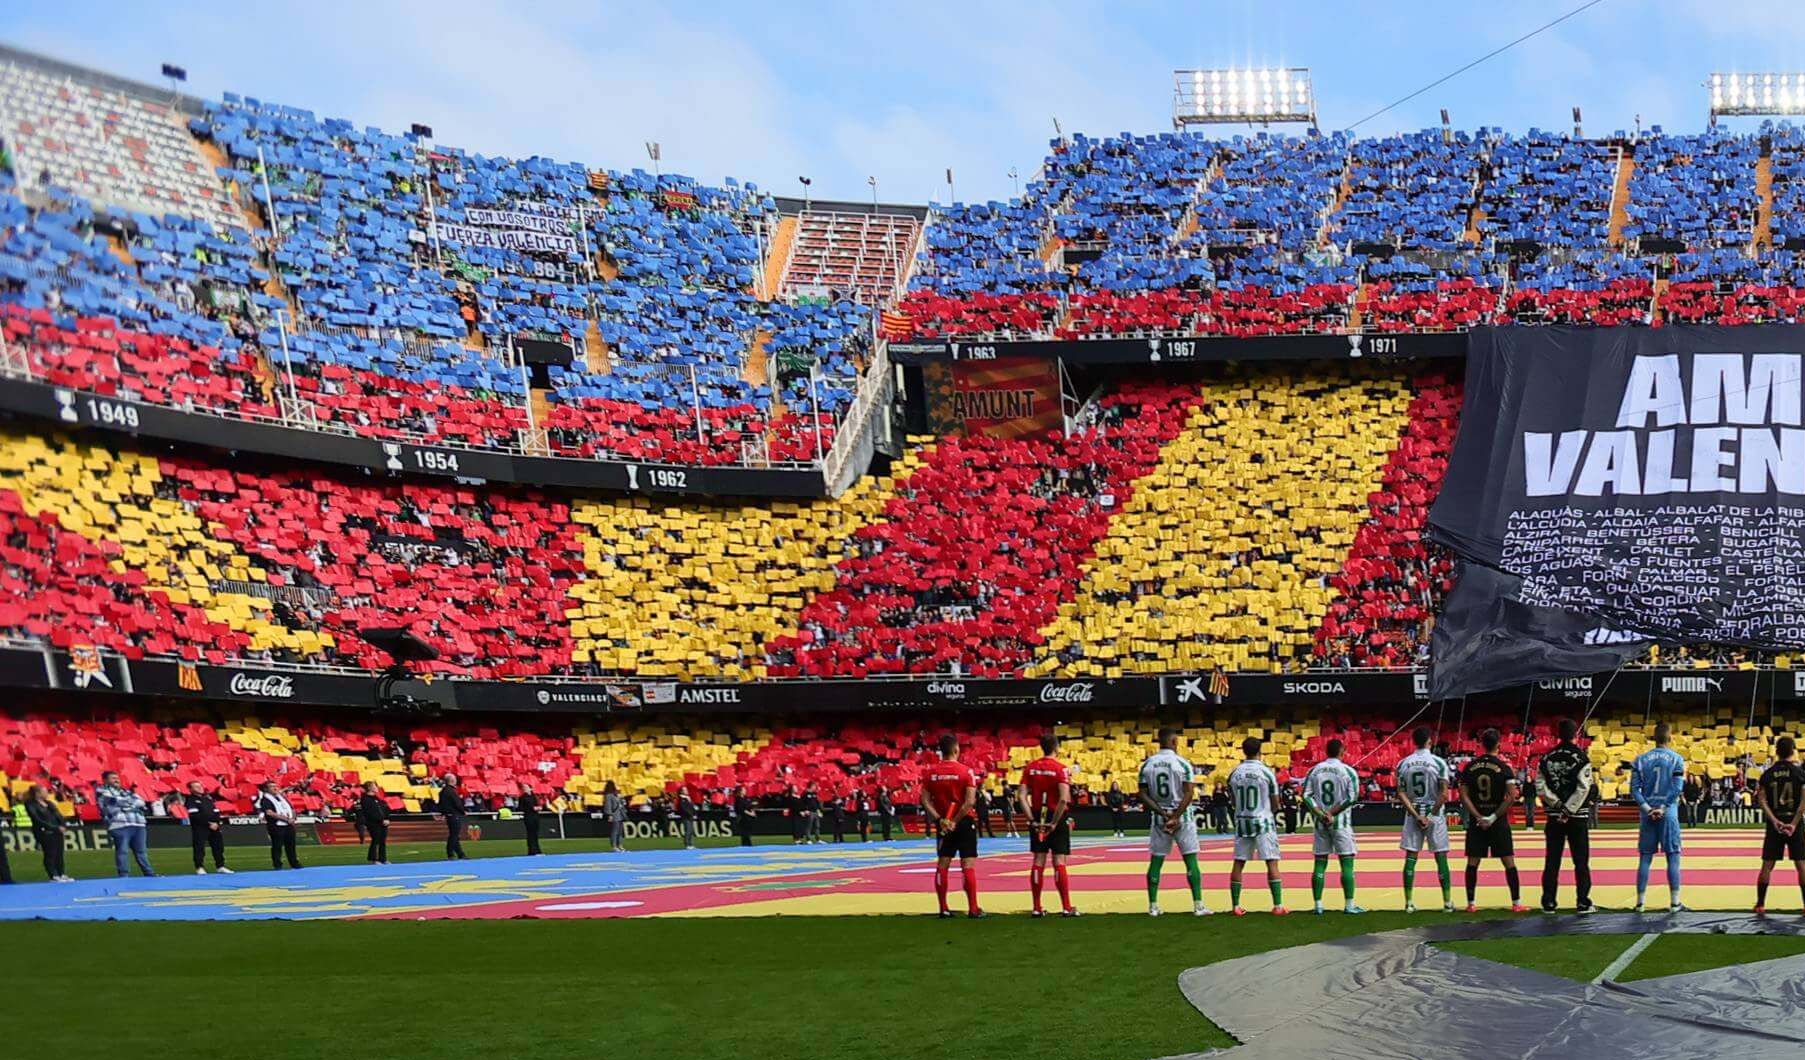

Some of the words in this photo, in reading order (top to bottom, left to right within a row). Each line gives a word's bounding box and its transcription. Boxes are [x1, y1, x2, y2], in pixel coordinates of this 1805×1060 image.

[1167, 341, 1196, 357] 1967
[1369, 338, 1397, 353] 1971
[967, 347, 996, 360] 1963
[951, 388, 1037, 420] AMUNT
[88, 400, 139, 427] 1949
[414, 451, 459, 471] 1954
[648, 469, 687, 488] 1962
[1594, 508, 1644, 518] ALBAL
[1655, 505, 1724, 515] ALBALAT
[1730, 507, 1750, 516] DE
[1755, 507, 1774, 516] LA
[1672, 515, 1743, 527] ALFAFAR
[1504, 529, 1561, 539] ALZIRA
[1721, 527, 1799, 538] BENICULL
[1723, 538, 1801, 548] BUGARRA
[1631, 546, 1694, 556] CARLET
[1539, 558, 1594, 573] AGUAS
[1726, 565, 1745, 576] EL
[1610, 557, 1640, 566] LAS
[1647, 557, 1722, 567] FUENTES
[1583, 570, 1626, 582] FORN
[1737, 588, 1758, 598] LA
[1614, 596, 1635, 609] LA
[926, 681, 965, 694] divina
[1283, 682, 1345, 693] SKODA
[1662, 677, 1706, 692] PUMA
[680, 688, 741, 703] AMSTEL
[1565, 690, 1592, 698] seguros
[1156, 772, 1170, 798] 6
[1412, 771, 1427, 798] 5
[1477, 774, 1492, 800] 9
[1653, 766, 1661, 793] 1
[1236, 785, 1258, 811] 10
[1321, 780, 1335, 806] 8
[1705, 808, 1764, 824] AMUNT
